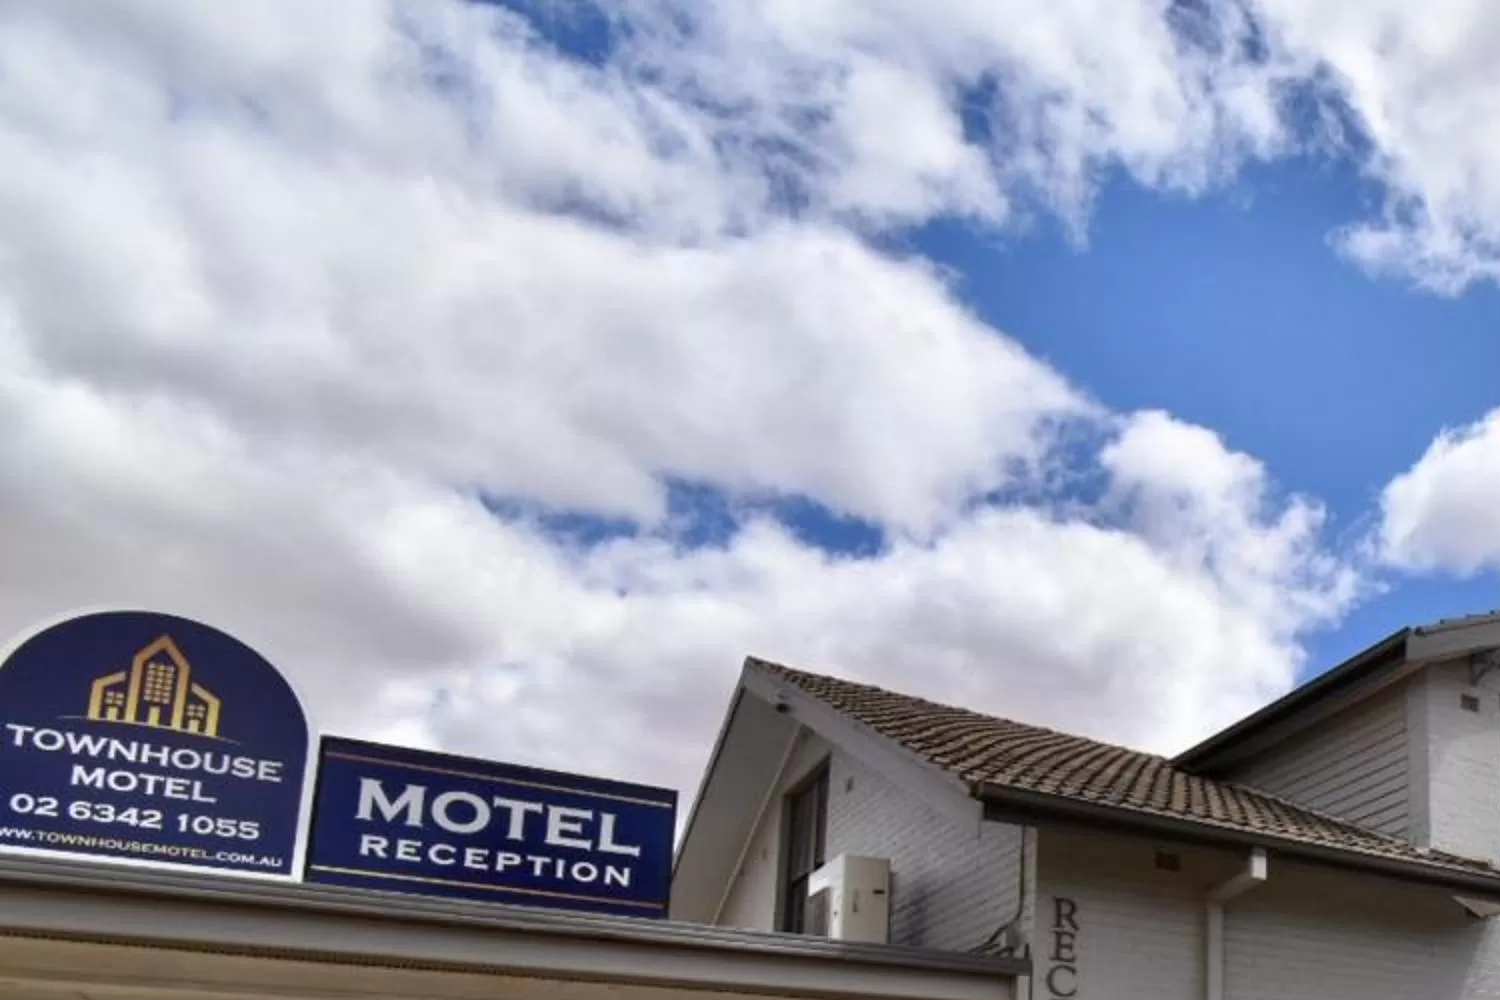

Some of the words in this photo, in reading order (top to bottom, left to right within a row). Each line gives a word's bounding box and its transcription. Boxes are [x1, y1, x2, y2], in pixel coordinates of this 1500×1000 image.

[5, 723, 284, 783] TOWNHOUSE
[71, 764, 217, 803] MOTEL
[9, 793, 59, 817] 02
[68, 801, 164, 829] 6342
[177, 813, 261, 840] 1055
[354, 777, 641, 857] MOTEL
[360, 833, 632, 888] RECEPTION
